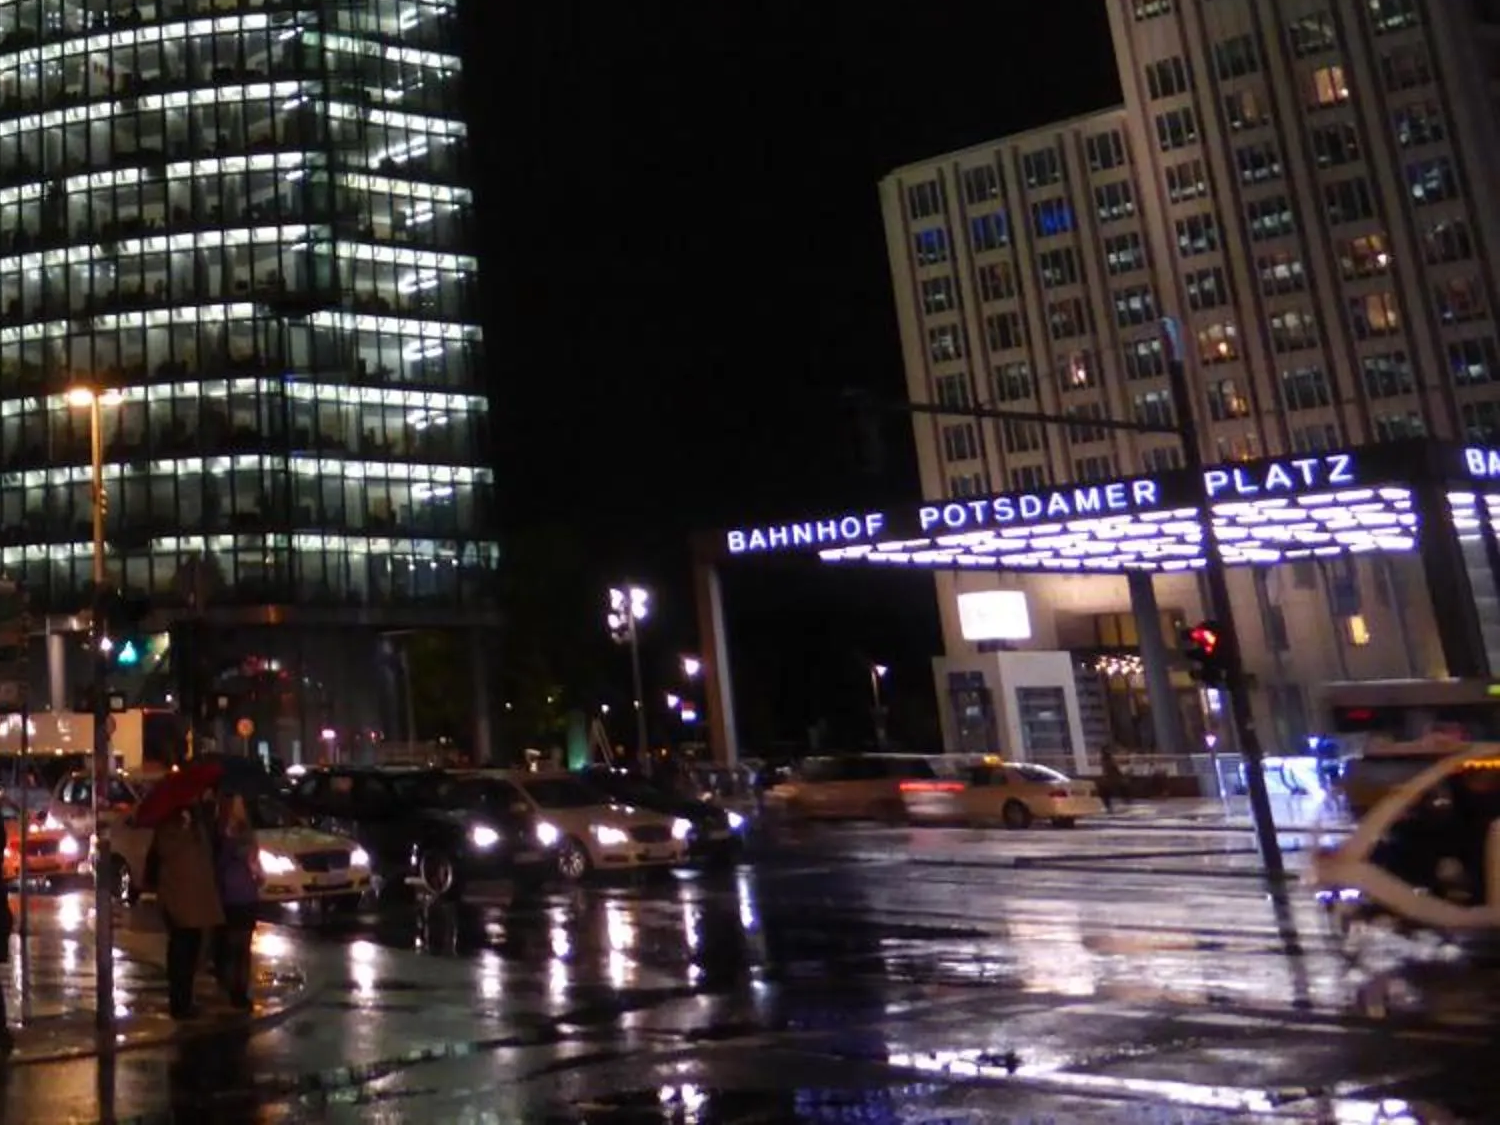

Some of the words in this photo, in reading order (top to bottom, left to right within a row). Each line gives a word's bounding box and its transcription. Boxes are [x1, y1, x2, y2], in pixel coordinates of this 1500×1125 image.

[726, 512, 884, 554] BAHNHOF
[918, 479, 1158, 531] POTSDAMER
[1203, 453, 1354, 497] PLATZ
